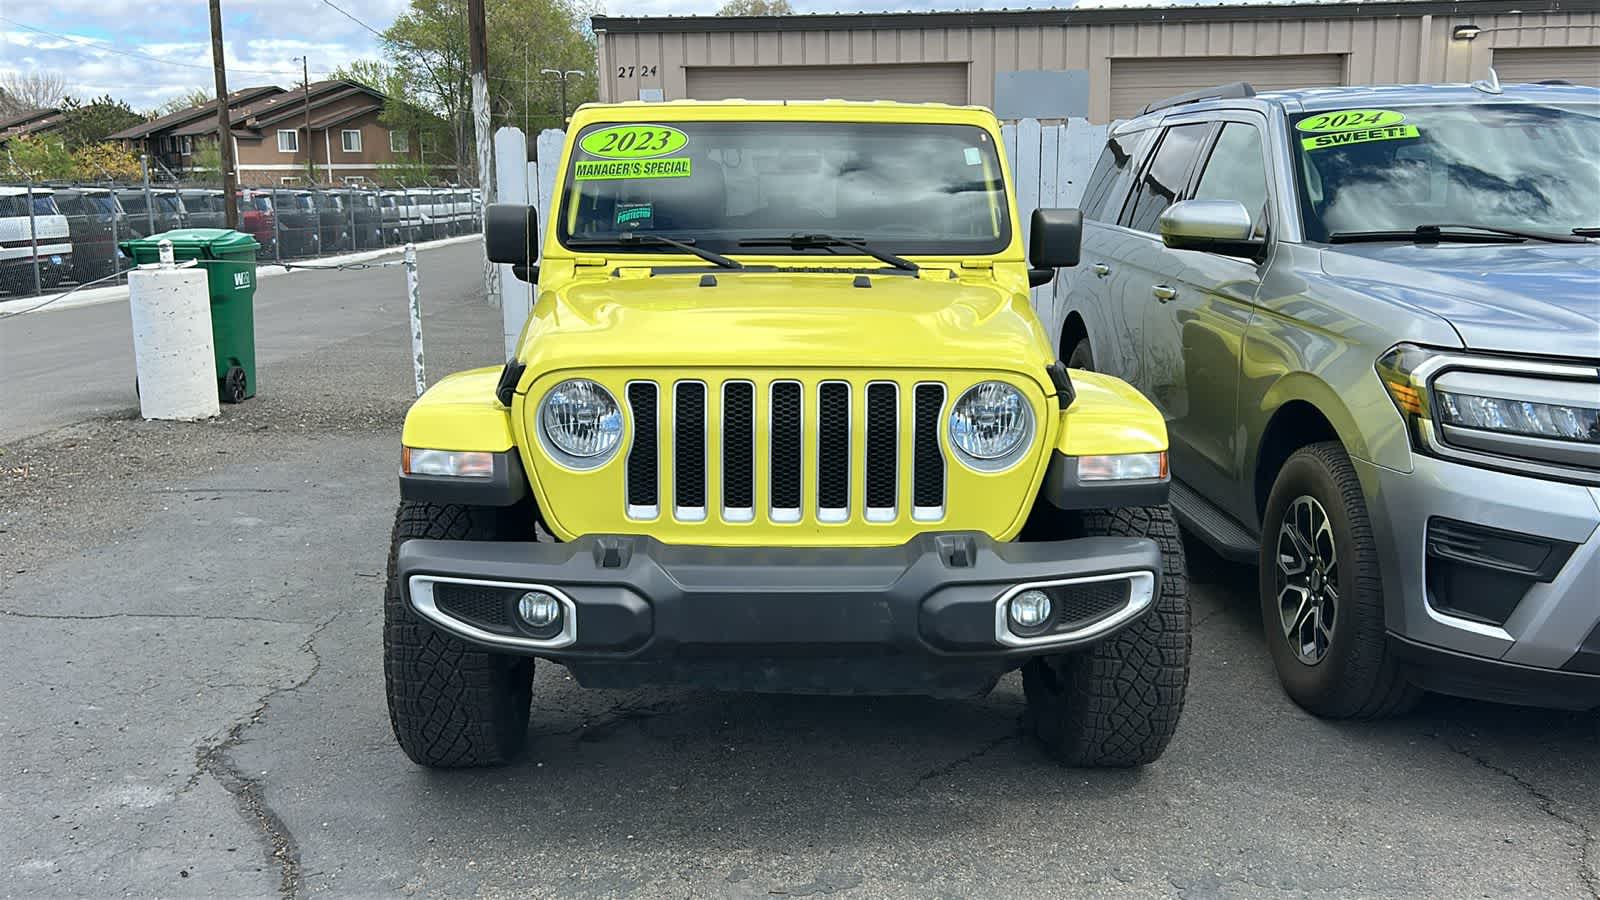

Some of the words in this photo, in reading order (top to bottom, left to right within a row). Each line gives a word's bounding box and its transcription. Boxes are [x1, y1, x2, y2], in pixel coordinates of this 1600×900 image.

[1312, 112, 1384, 129] 2024
[598, 131, 672, 153] 2023
[1315, 127, 1405, 146] SWEET!
[576, 163, 641, 176] MANAGER'S
[644, 161, 688, 173] SPECIAL
